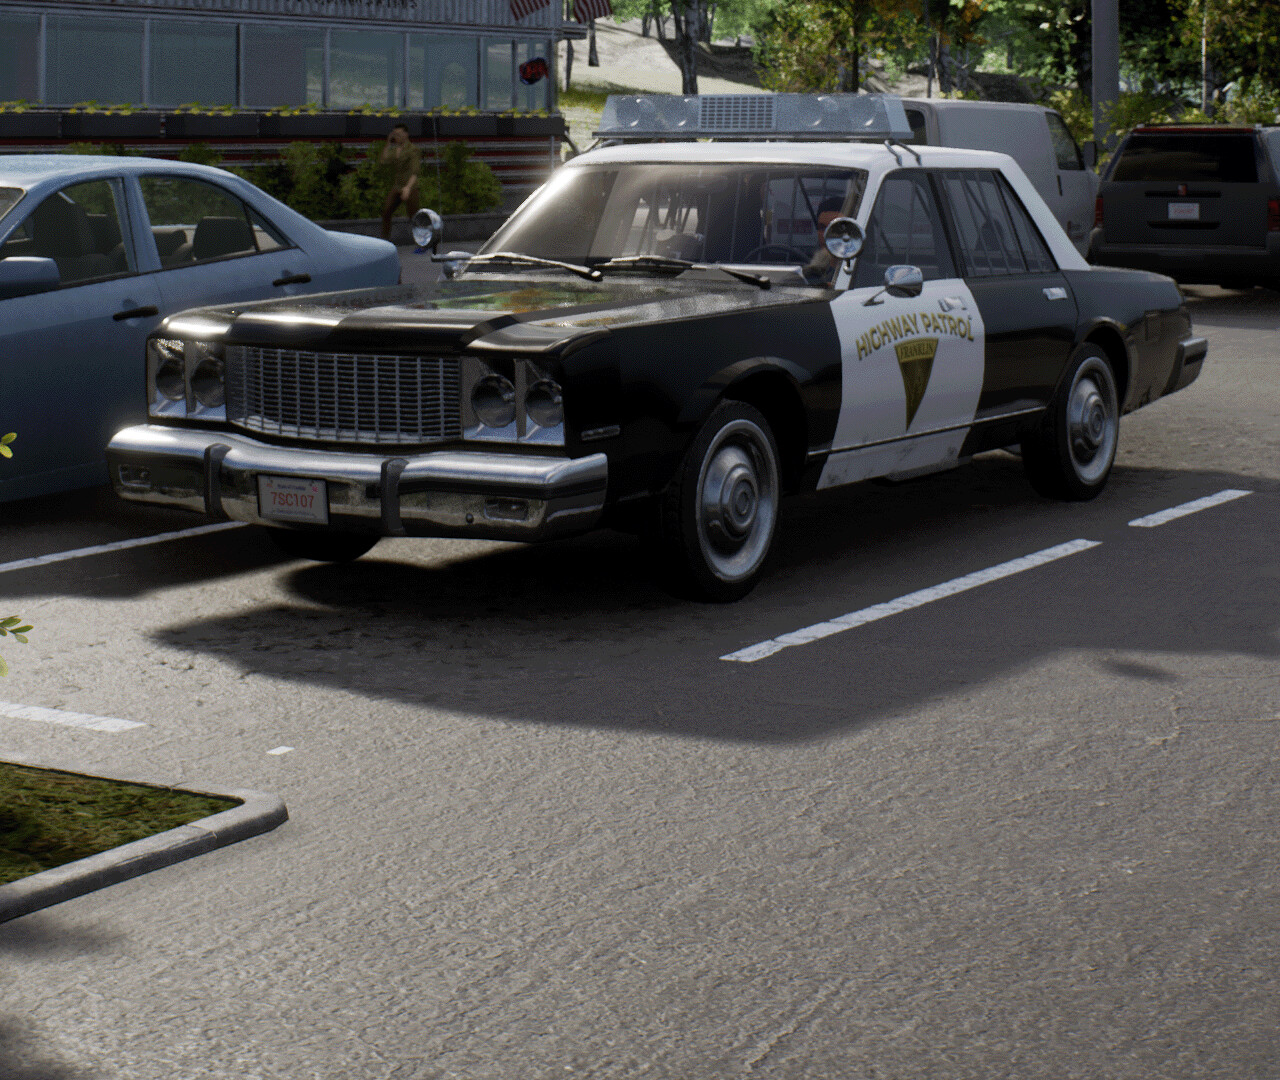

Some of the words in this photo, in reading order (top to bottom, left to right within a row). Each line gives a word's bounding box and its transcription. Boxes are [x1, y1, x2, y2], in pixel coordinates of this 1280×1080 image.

[855, 312, 920, 361] HIGHWAY
[920, 312, 974, 342] PATROL
[270, 491, 315, 509] 7SC107
